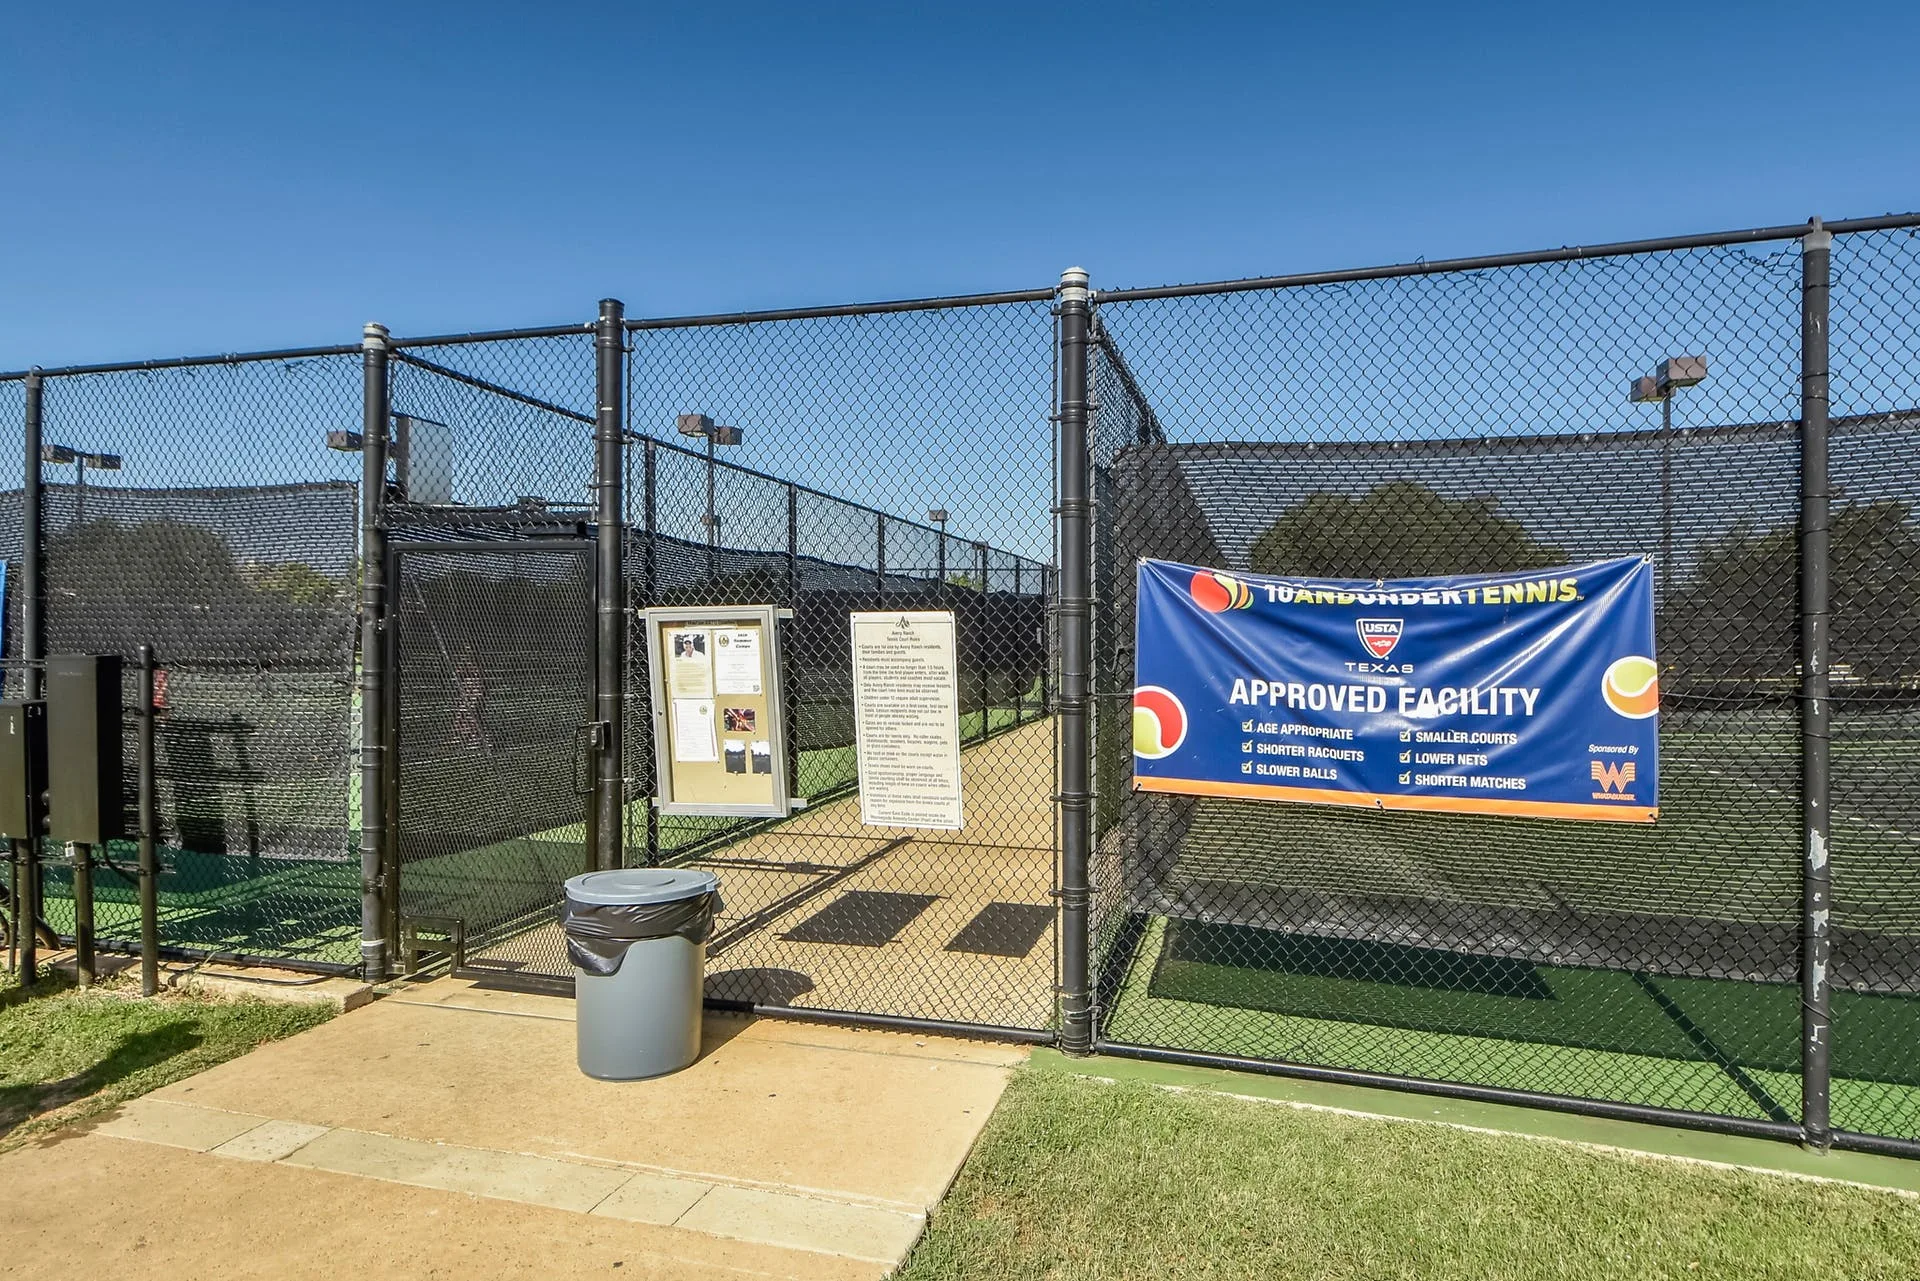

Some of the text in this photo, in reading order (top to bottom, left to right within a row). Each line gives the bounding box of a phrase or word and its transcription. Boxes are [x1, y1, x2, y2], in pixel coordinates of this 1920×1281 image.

[1365, 623, 1399, 633] USTA
[1344, 662, 1414, 674] TEXAS
[1229, 678, 1541, 716] APPROVED FACILITY
[1256, 723, 1354, 740] AGE APPROPRIATE
[1416, 731, 1518, 744] SMALLER COURTS
[1256, 743, 1365, 762] SHORTER RACQUETS
[1588, 744, 1640, 756] Sponsored By
[1415, 752, 1489, 766] LOWER NETS
[1256, 764, 1338, 780] SLOWER BALLS
[1415, 773, 1527, 790] SHORTER MATCHES
